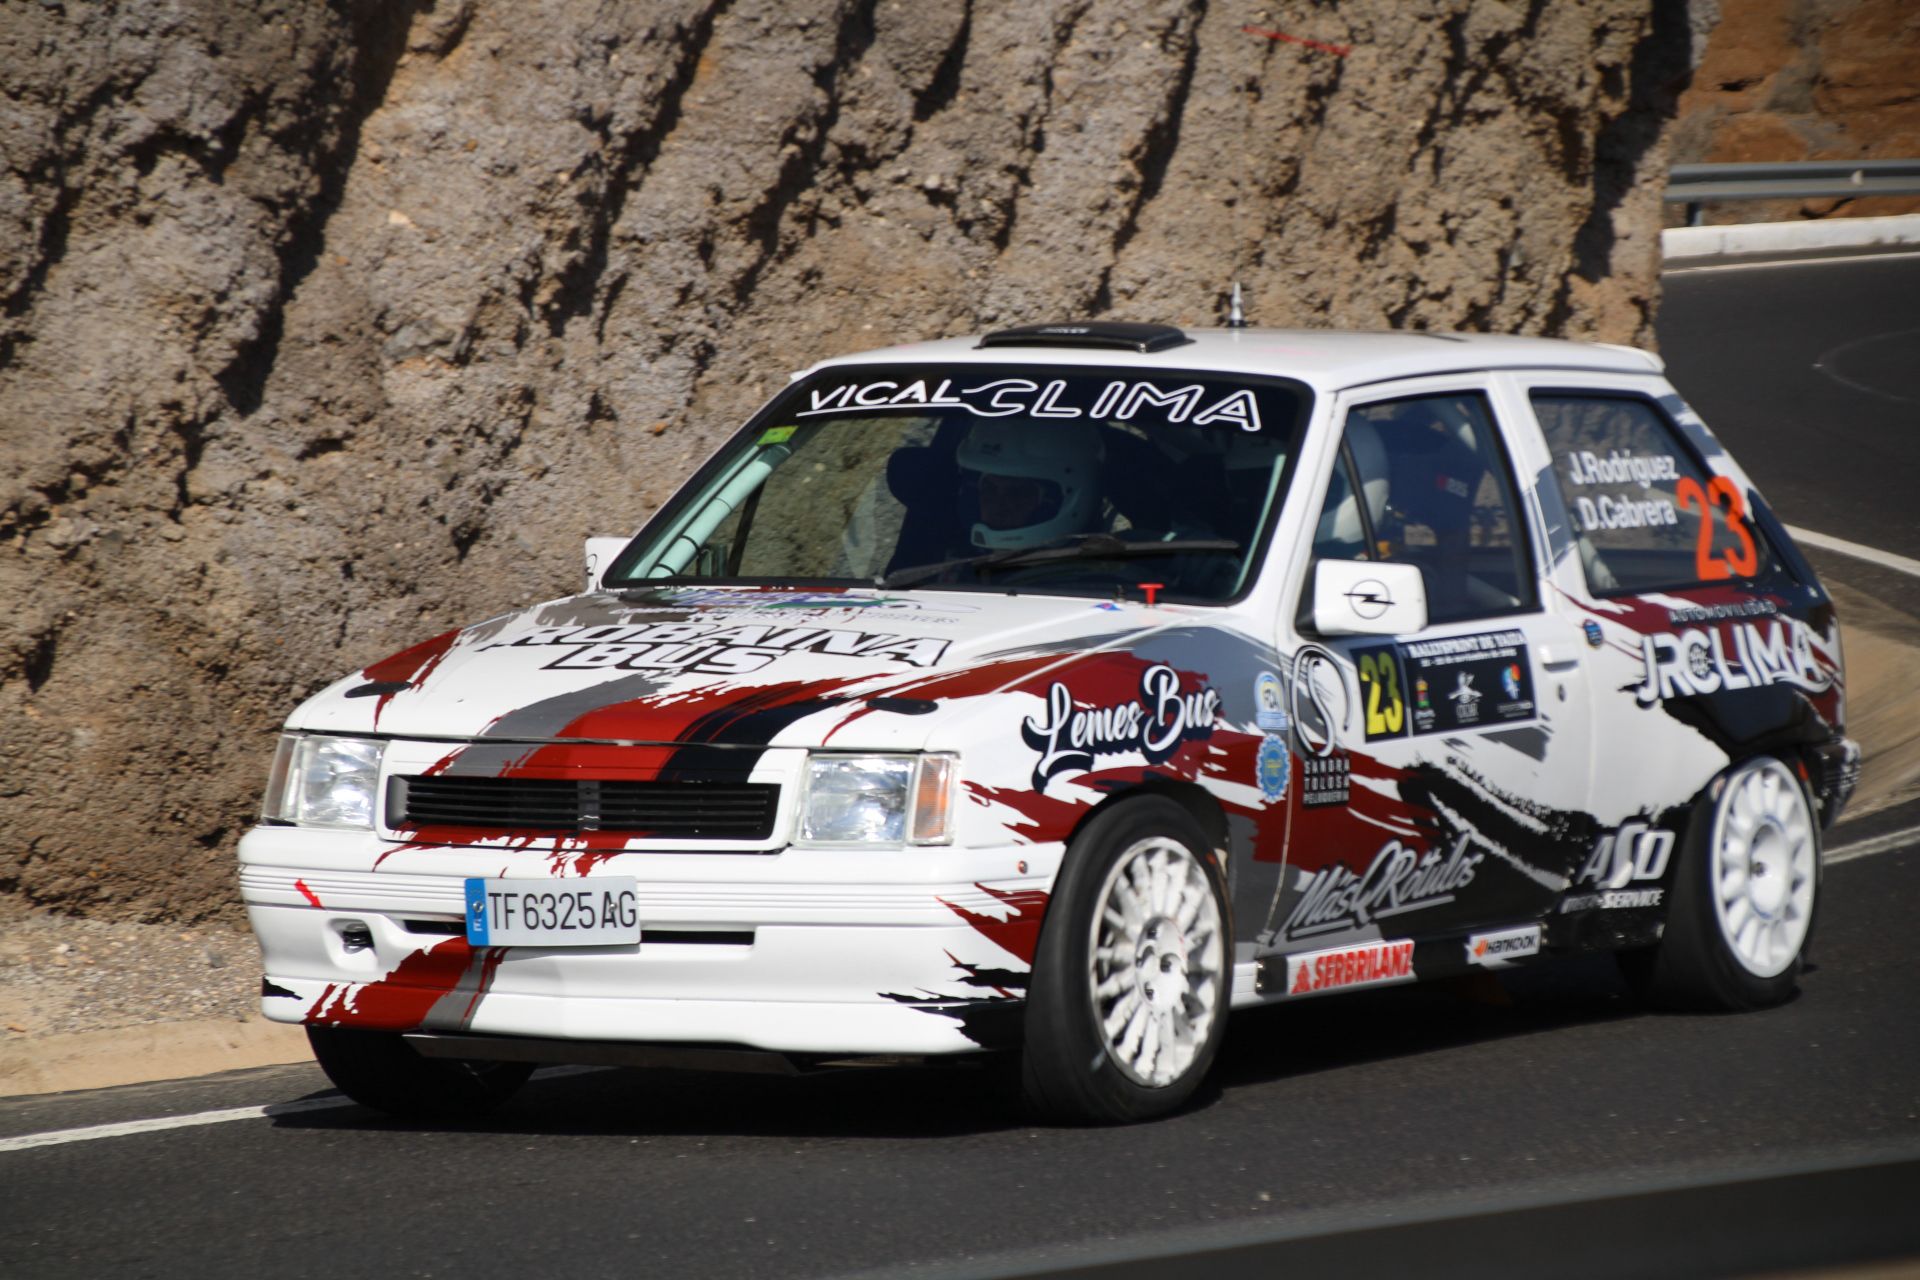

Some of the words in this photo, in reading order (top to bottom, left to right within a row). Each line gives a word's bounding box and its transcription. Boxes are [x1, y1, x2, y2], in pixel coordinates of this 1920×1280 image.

[1577, 494, 1679, 531] D.Cabrera
[1676, 475, 1758, 581] 23
[540, 643, 787, 676] BUS
[1360, 651, 1404, 736] 23
[1022, 680, 1146, 782] Lemes
[1142, 663, 1221, 753] Bus
[1303, 757, 1351, 775] SANDRA
[1303, 774, 1351, 791] TOLOSA
[1576, 821, 1676, 890] ASD
[473, 919, 483, 932] E
